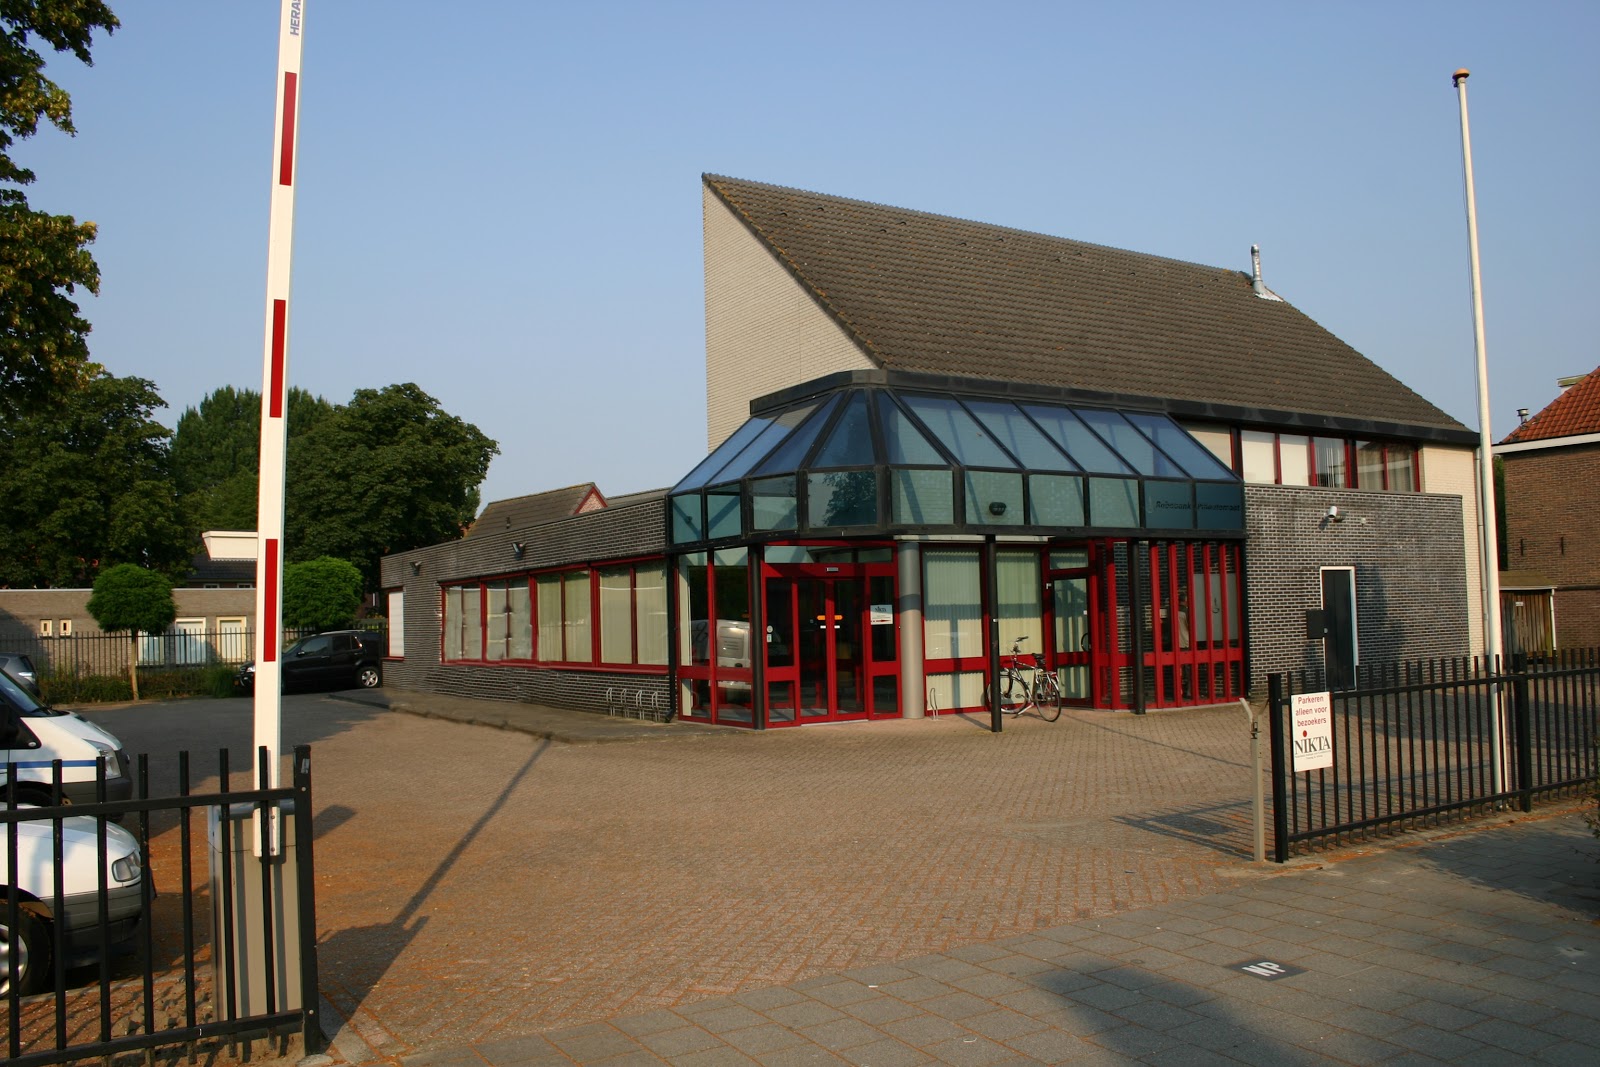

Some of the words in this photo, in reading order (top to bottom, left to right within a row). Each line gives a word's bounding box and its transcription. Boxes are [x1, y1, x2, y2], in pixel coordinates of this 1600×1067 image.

[290, 0, 301, 36] HERA
[1298, 696, 1324, 705] Parkeren
[1295, 708, 1313, 716] alleen
[1297, 717, 1327, 726] bezoekers
[1294, 736, 1331, 755] NIKTA
